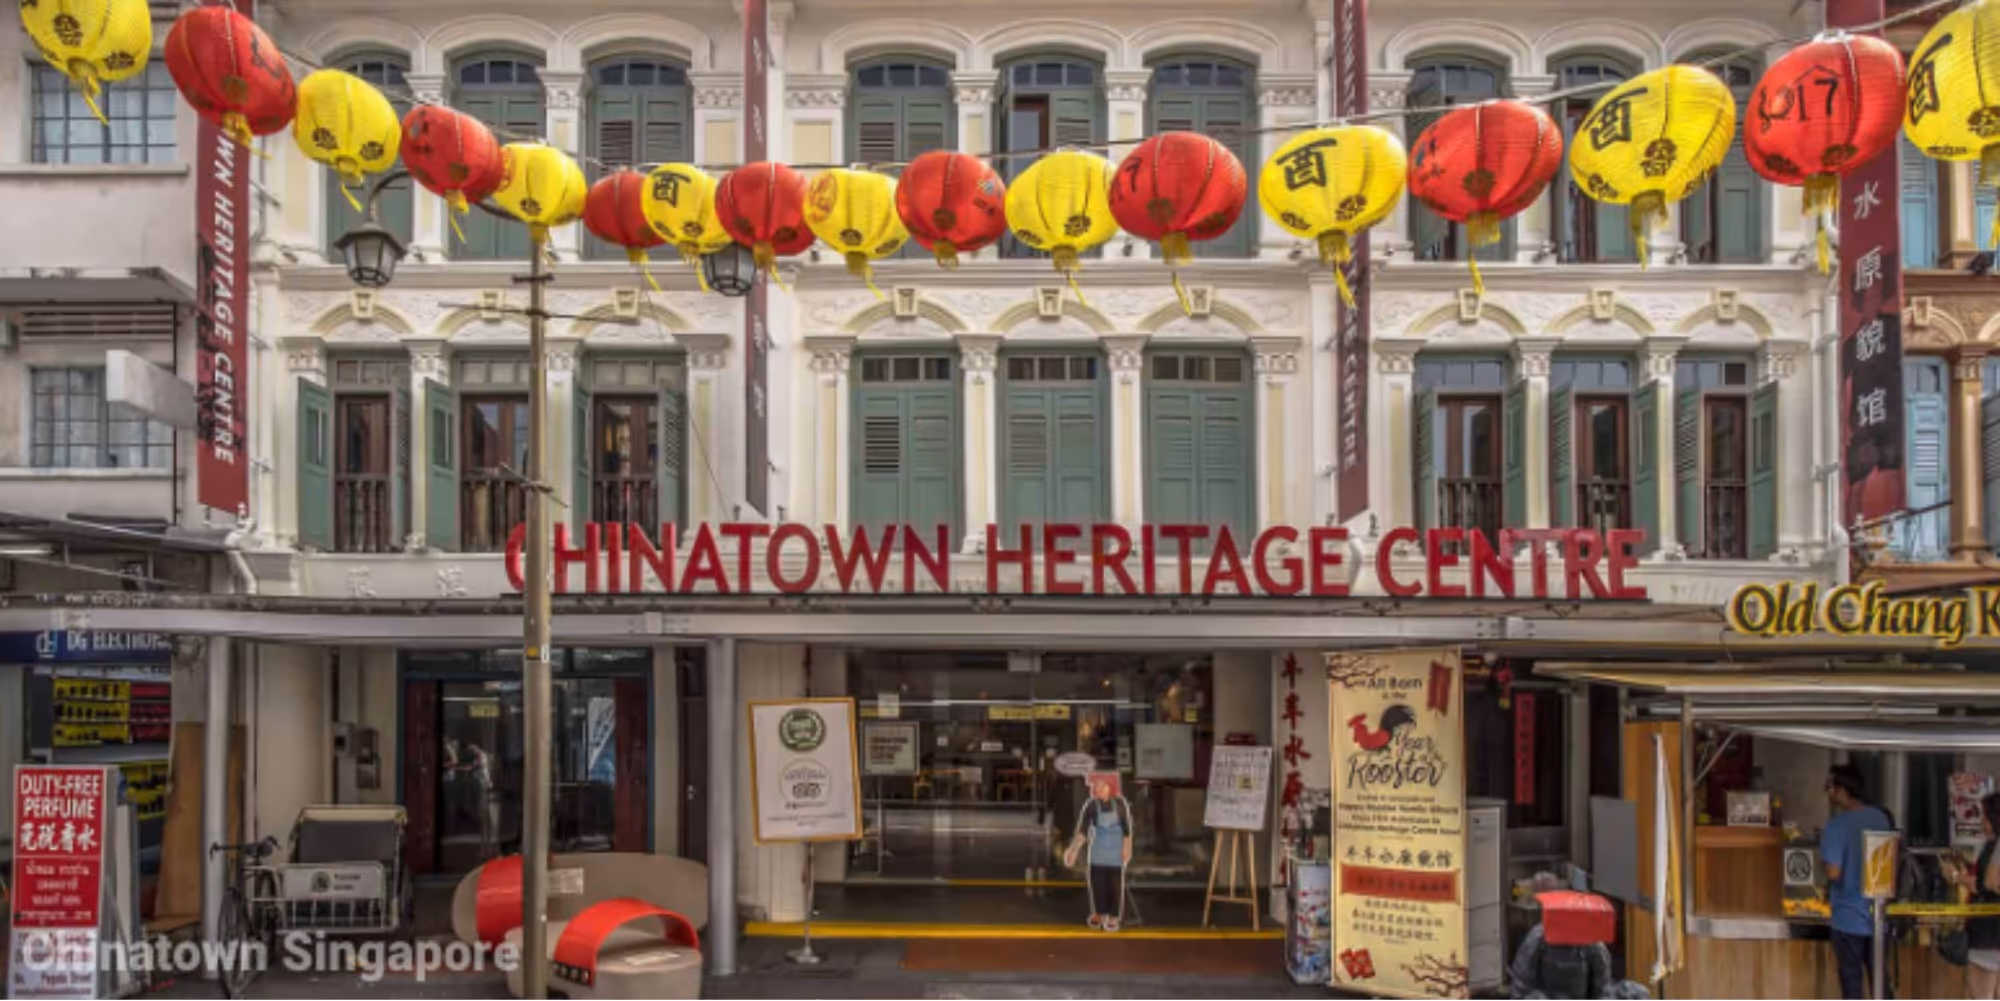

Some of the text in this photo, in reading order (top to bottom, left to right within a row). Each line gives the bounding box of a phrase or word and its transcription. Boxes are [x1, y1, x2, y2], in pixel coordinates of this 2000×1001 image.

[214, 190, 235, 345] HERITAGE
[214, 352, 235, 465] CENTRE
[985, 523, 1350, 597] HERITAGE
[1375, 526, 1648, 599] CENTRE
[1727, 580, 1818, 636] Old
[1819, 580, 1969, 649] Chang
[20, 774, 101, 797] DUTY-FREE
[1346, 751, 1448, 790] Rooster
[23, 798, 96, 819] PERFUME
